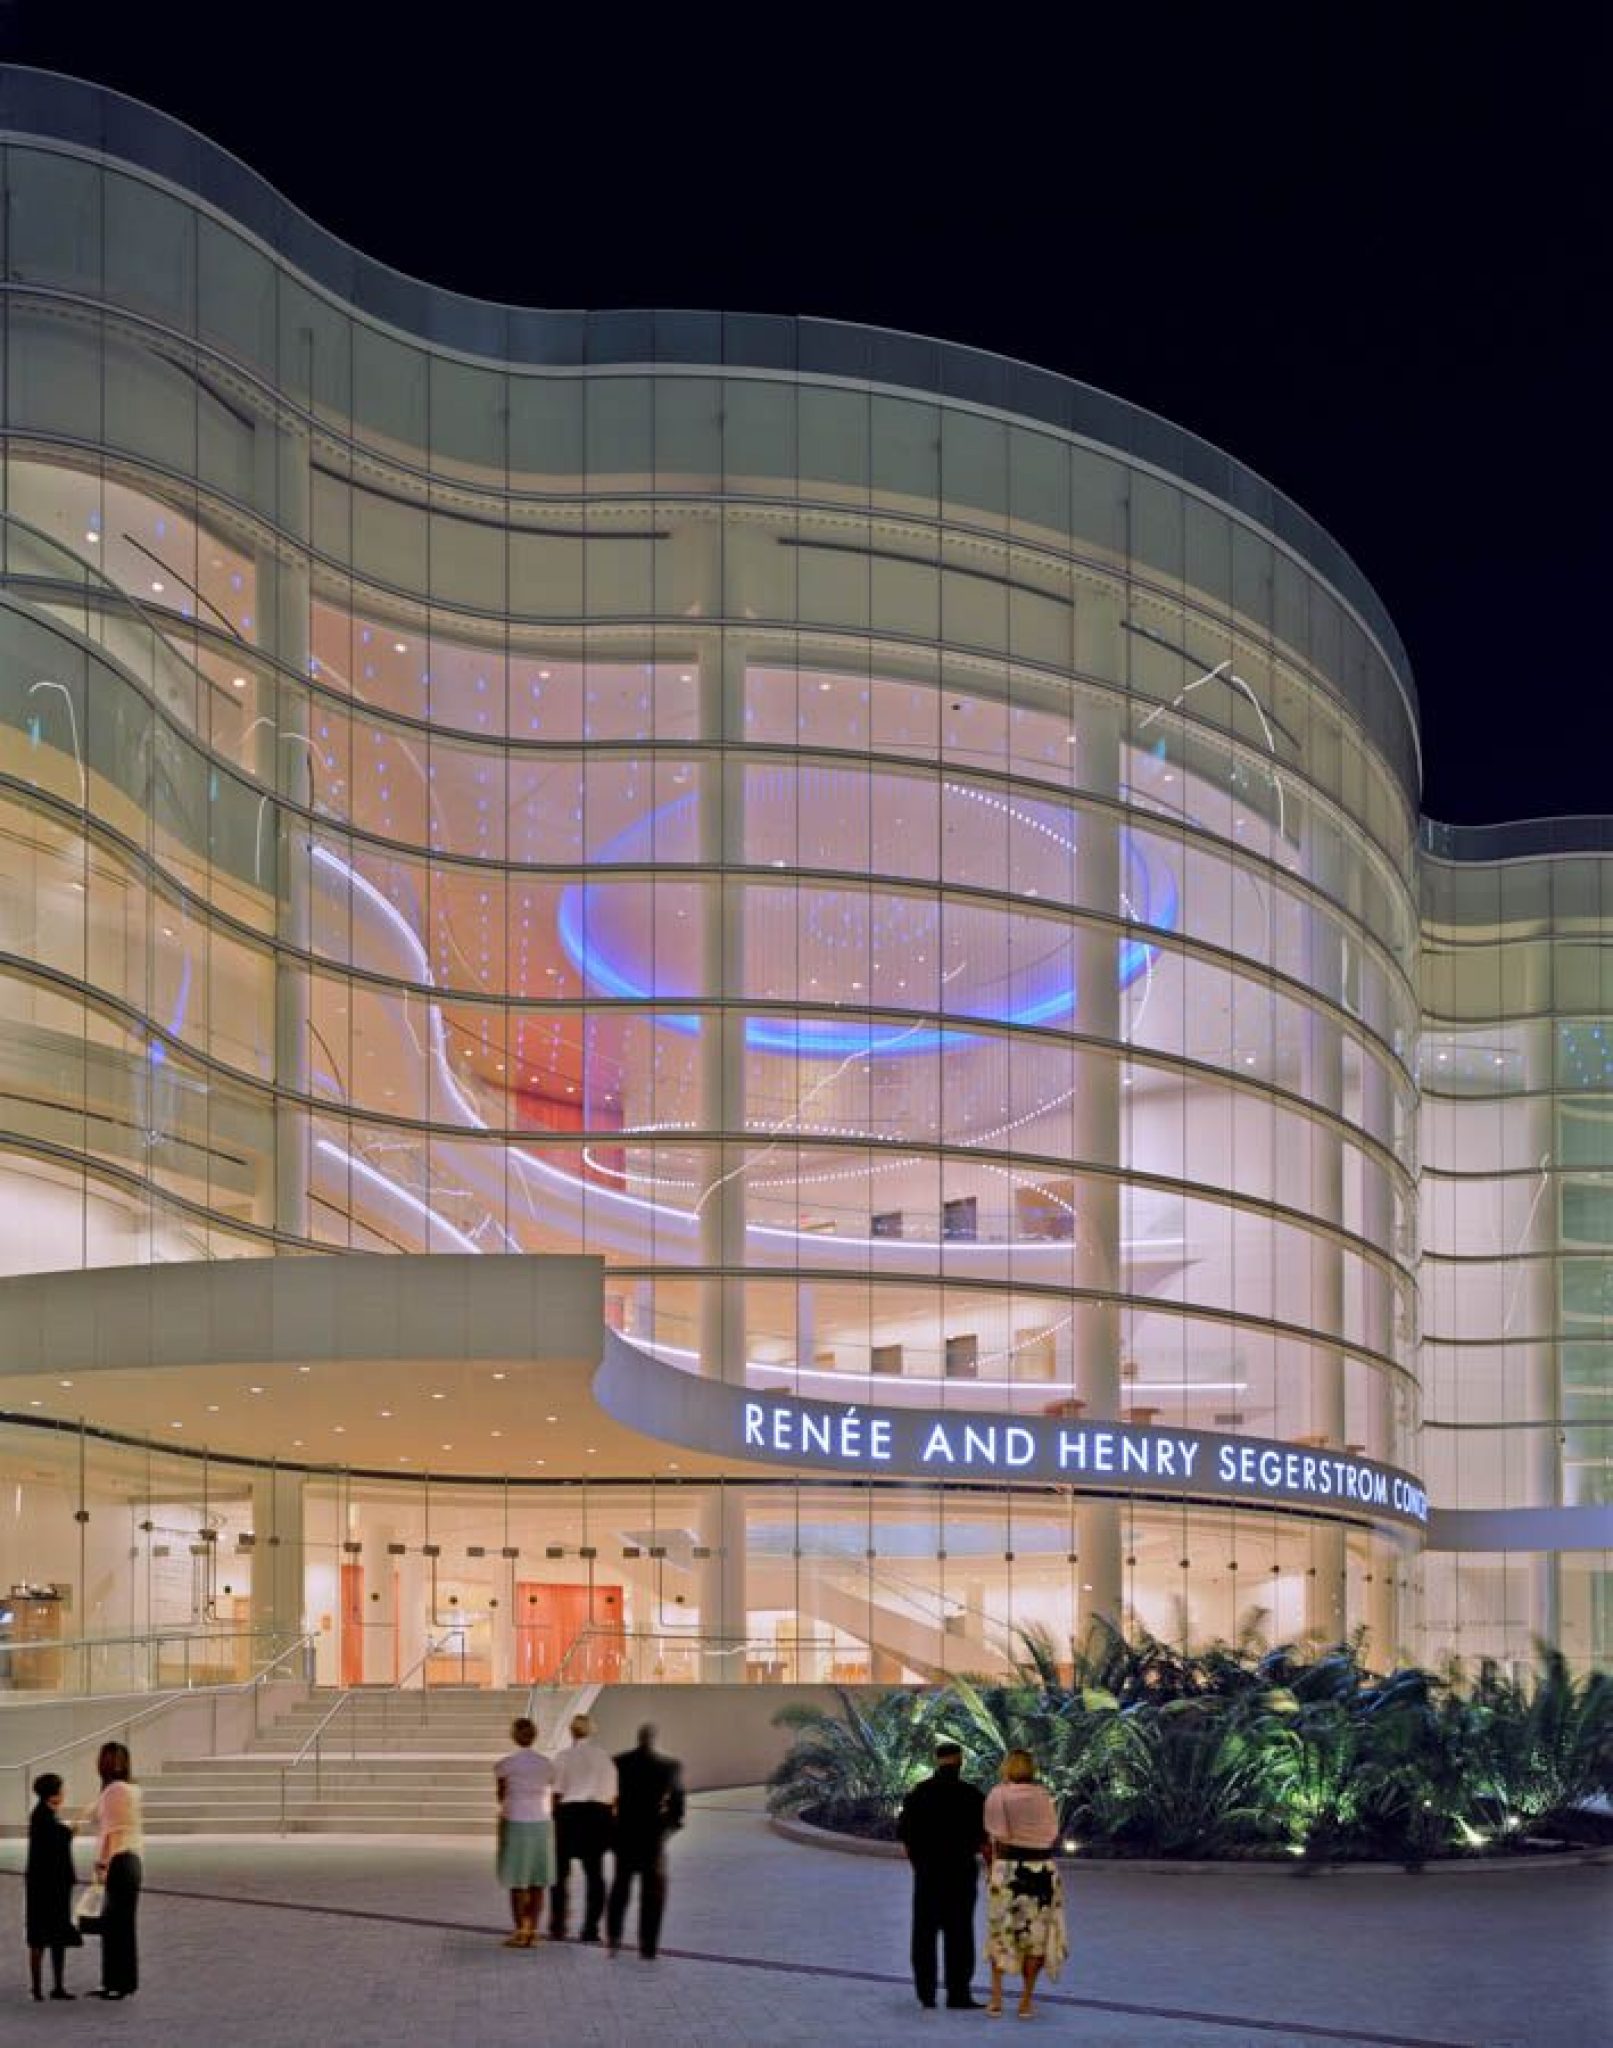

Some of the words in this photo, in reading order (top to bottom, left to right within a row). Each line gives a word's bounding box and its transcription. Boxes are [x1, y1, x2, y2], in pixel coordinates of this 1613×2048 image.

[745, 1403, 892, 1459] RENÉE
[923, 1424, 1035, 1465] AND
[1059, 1430, 1199, 1477] HENRY
[1219, 1445, 1388, 1504] SEGERSTROM
